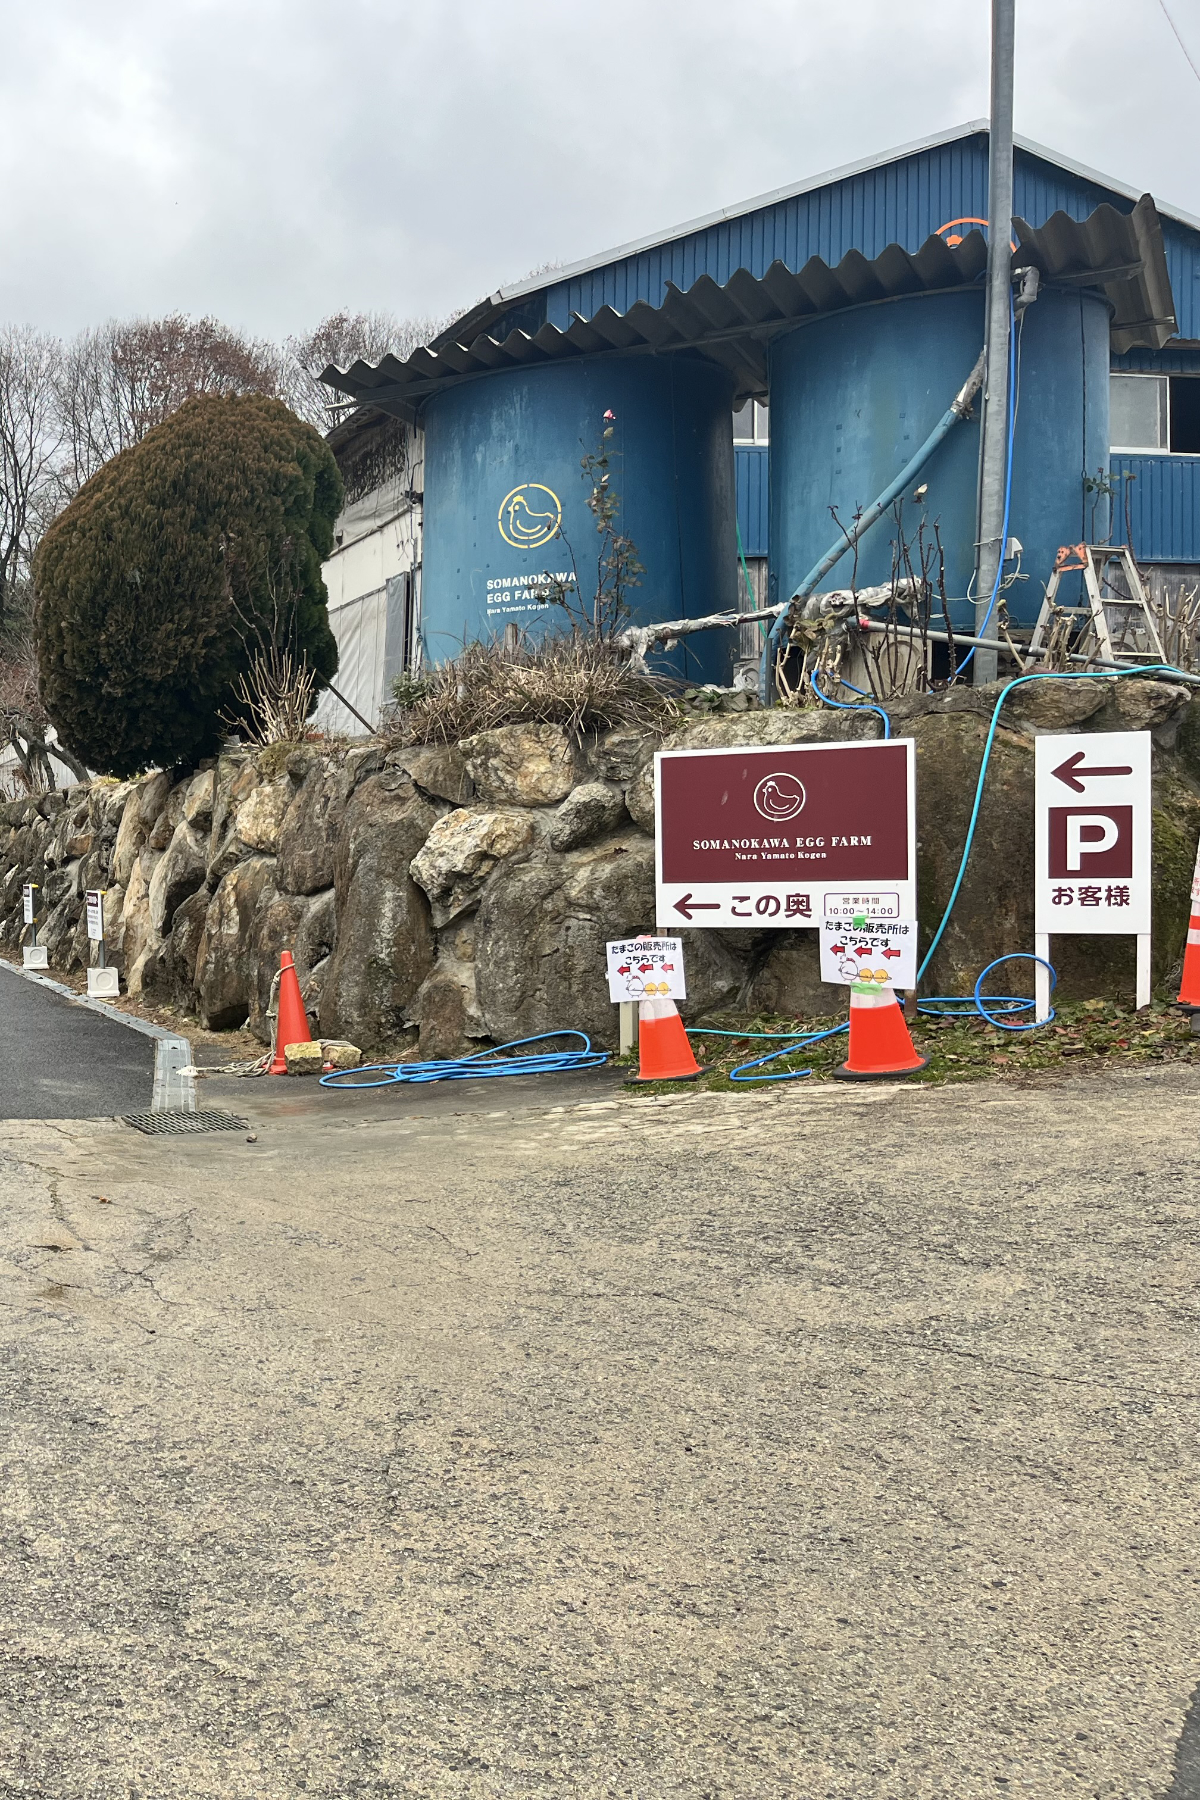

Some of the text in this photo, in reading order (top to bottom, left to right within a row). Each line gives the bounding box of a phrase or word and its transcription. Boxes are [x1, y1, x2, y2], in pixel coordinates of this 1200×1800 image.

[486, 571, 577, 590] SOMANOKAWA
[486, 591, 511, 604] EGG
[502, 605, 526, 613] Yamato
[527, 603, 549, 612] Kogen
[692, 836, 872, 850] SOMANOKAWA EGG FARM
[1066, 814, 1119, 871] P
[735, 851, 827, 860] Nara Yamato Kogen
[842, 897, 880, 905] 営業時間
[1051, 885, 1131, 908] お客様
[730, 893, 813, 918] この奥
[839, 935, 891, 947] こちらです
[625, 954, 666, 966] こちらです
